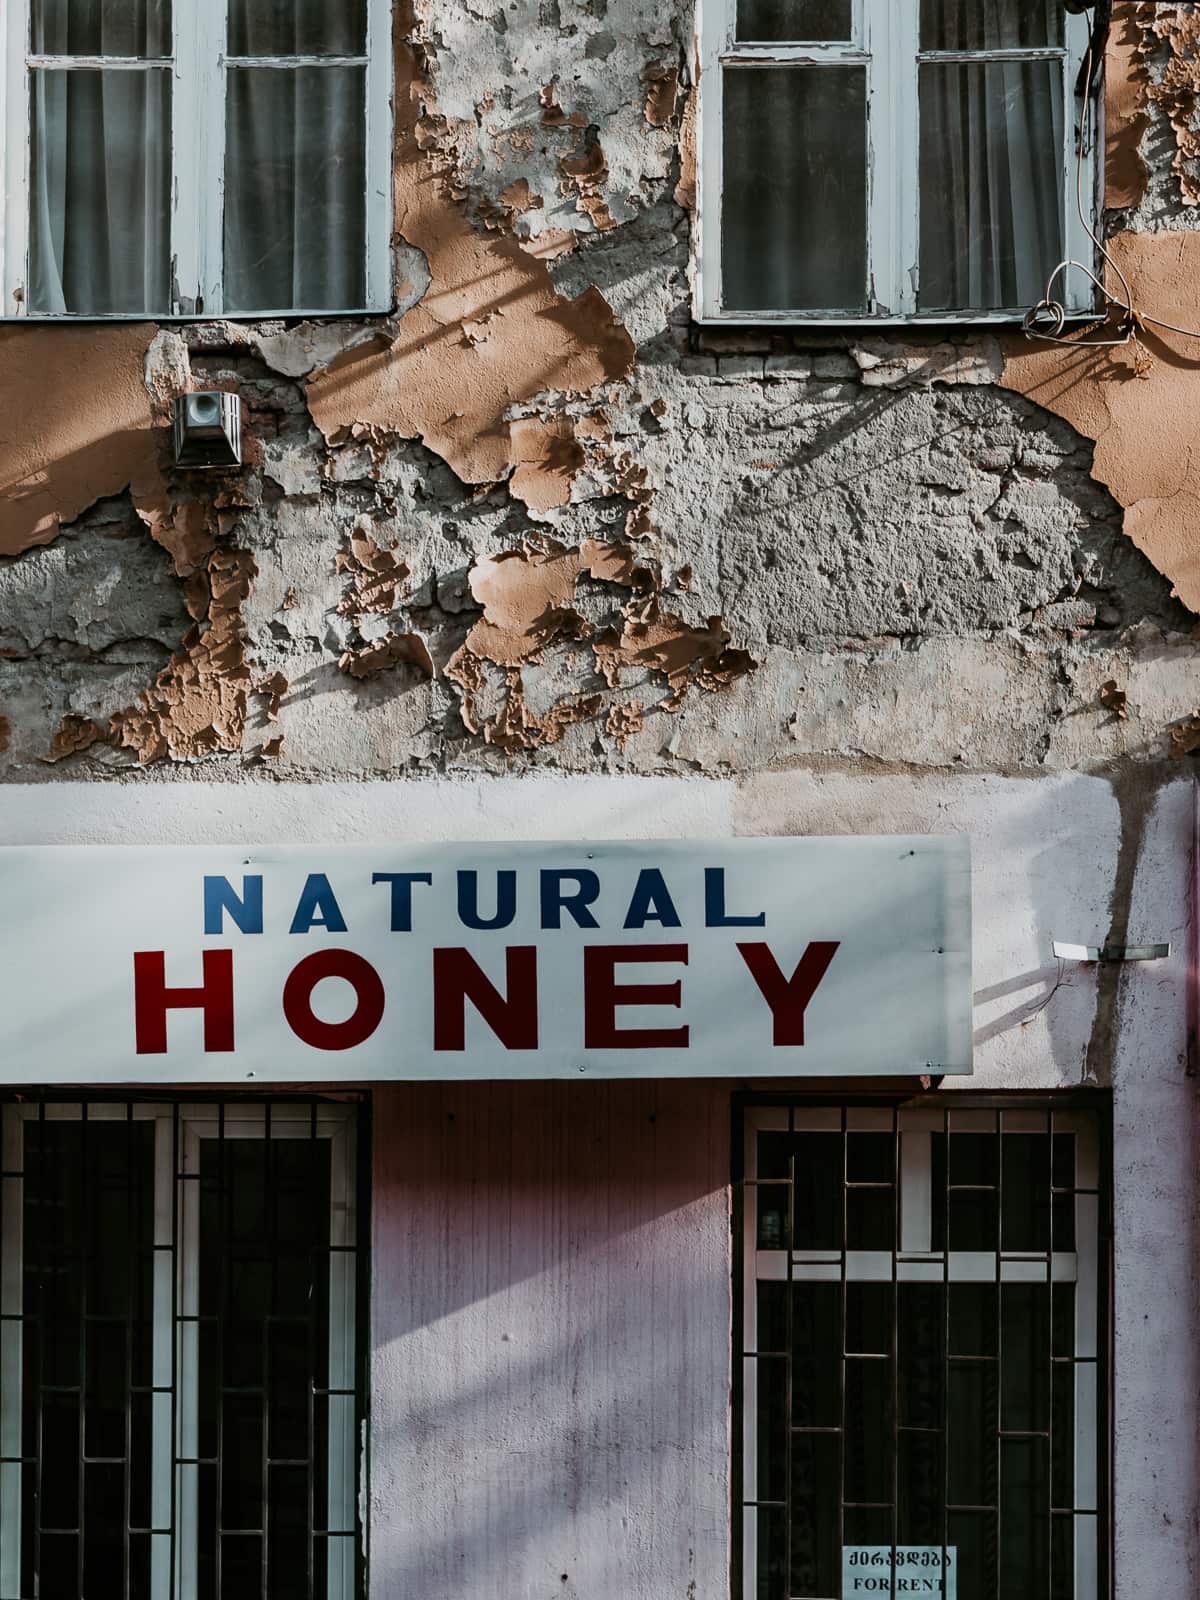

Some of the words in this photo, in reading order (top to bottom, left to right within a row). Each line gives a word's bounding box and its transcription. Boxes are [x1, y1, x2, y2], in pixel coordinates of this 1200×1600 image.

[203, 867, 766, 935] NATURAL
[133, 940, 841, 1055] HONEY
[853, 1578, 890, 1591] FOR
[897, 1578, 946, 1591] RENT
